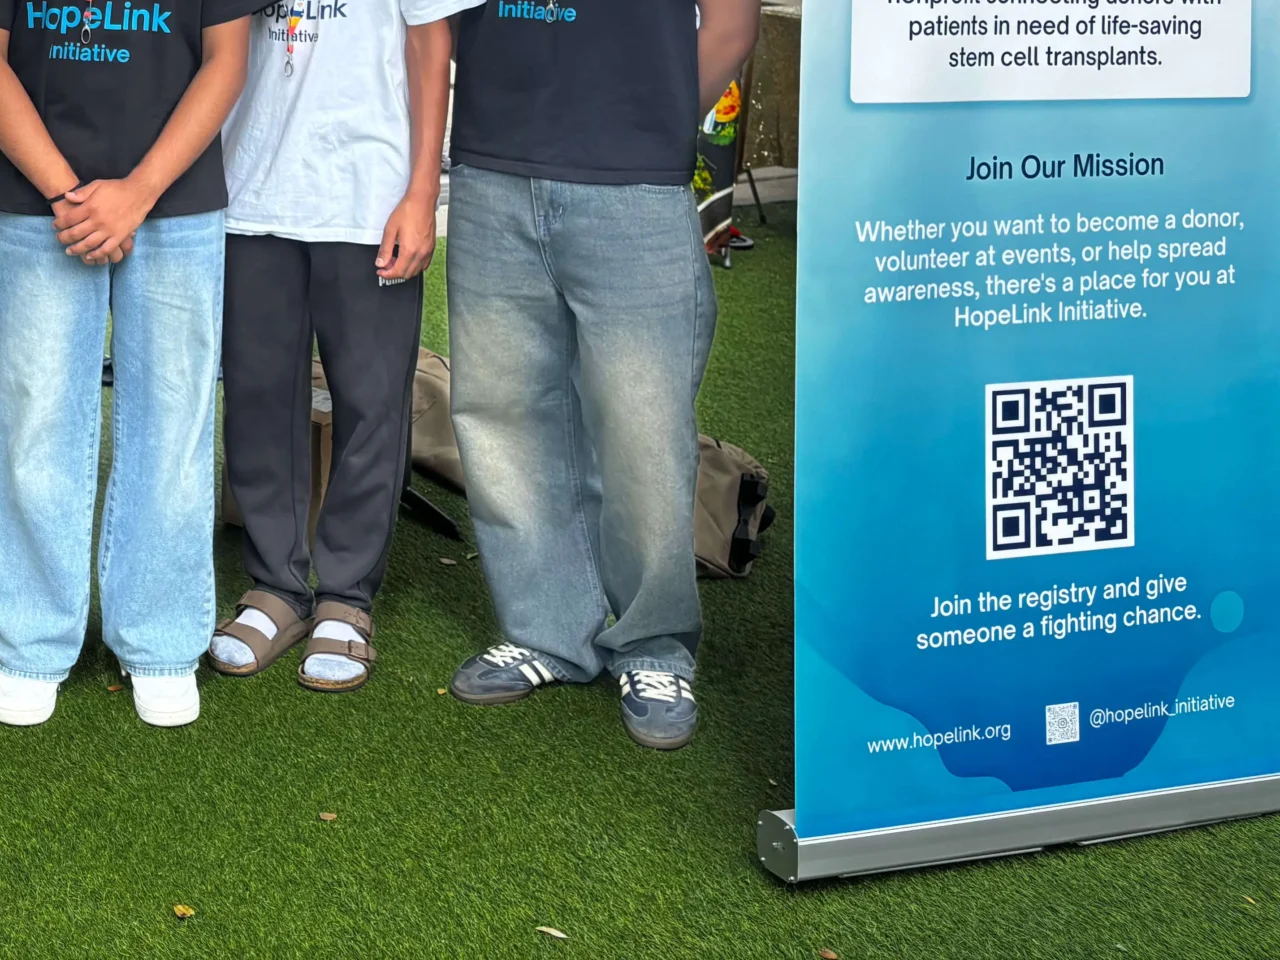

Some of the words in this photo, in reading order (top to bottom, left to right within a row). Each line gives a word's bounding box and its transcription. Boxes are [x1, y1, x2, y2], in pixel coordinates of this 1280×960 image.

[26, 1, 172, 34] HopeLink
[909, 16, 988, 41] patients
[994, 15, 1010, 35] in
[1017, 15, 1069, 35] need
[1076, 15, 1096, 35] of
[1101, 15, 1202, 39] life-saving
[949, 48, 994, 67] stem
[1001, 46, 1039, 67] cell
[1046, 45, 1162, 70] transplants.
[966, 155, 1012, 181] Join
[1021, 154, 1066, 180] Our
[1073, 152, 1164, 178] Mission
[855, 219, 945, 242] Whether
[951, 219, 987, 242] you
[994, 214, 1044, 236] want
[1050, 213, 1070, 233] to
[1077, 210, 1158, 231] become
[1165, 214, 1176, 229] a
[1182, 208, 1244, 231] donor,
[875, 249, 969, 272] volunteer
[975, 246, 996, 266] at
[1002, 242, 1076, 267] events,
[1082, 243, 1102, 262] or
[1108, 239, 1152, 263] help
[1158, 236, 1226, 263] spread
[864, 277, 980, 303] awareness,
[986, 273, 1056, 297] there's
[1062, 275, 1073, 292] a
[1080, 270, 1136, 296] place
[1141, 268, 1169, 288] for
[1175, 267, 1210, 291] you
[1216, 264, 1235, 284] at
[954, 302, 1052, 330] HopeLink
[1059, 299, 1146, 322] Initiative.
[931, 594, 971, 618] Join
[978, 591, 1011, 611] the
[1018, 582, 1097, 612] registry
[1103, 576, 1140, 601] and
[1146, 573, 1187, 598] give
[917, 622, 1016, 649] someone
[1023, 620, 1034, 638] a
[1040, 609, 1117, 639] fighting
[1123, 602, 1201, 627] chance.
[868, 722, 1011, 754] www.hopelink.org
[1090, 693, 1235, 728] @hopelink_initiative
